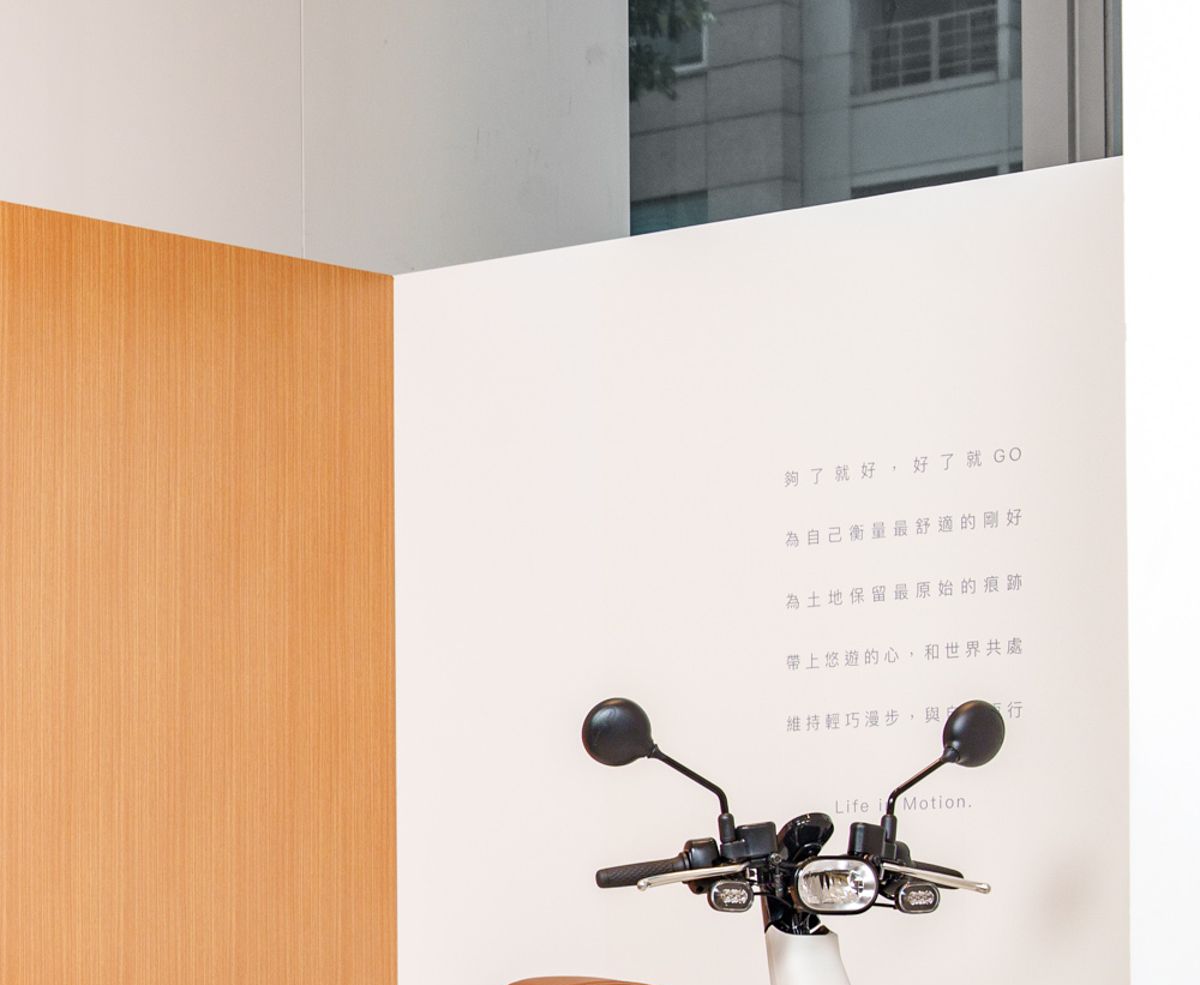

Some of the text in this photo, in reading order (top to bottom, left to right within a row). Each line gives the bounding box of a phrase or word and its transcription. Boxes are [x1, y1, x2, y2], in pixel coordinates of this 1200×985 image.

[785, 507, 1023, 548] 為自己衡量最舒適的剛好
[785, 573, 1023, 610] 為土地保留最原始的痕跡
[834, 798, 870, 815] Life
[902, 795, 973, 812] Motion.
